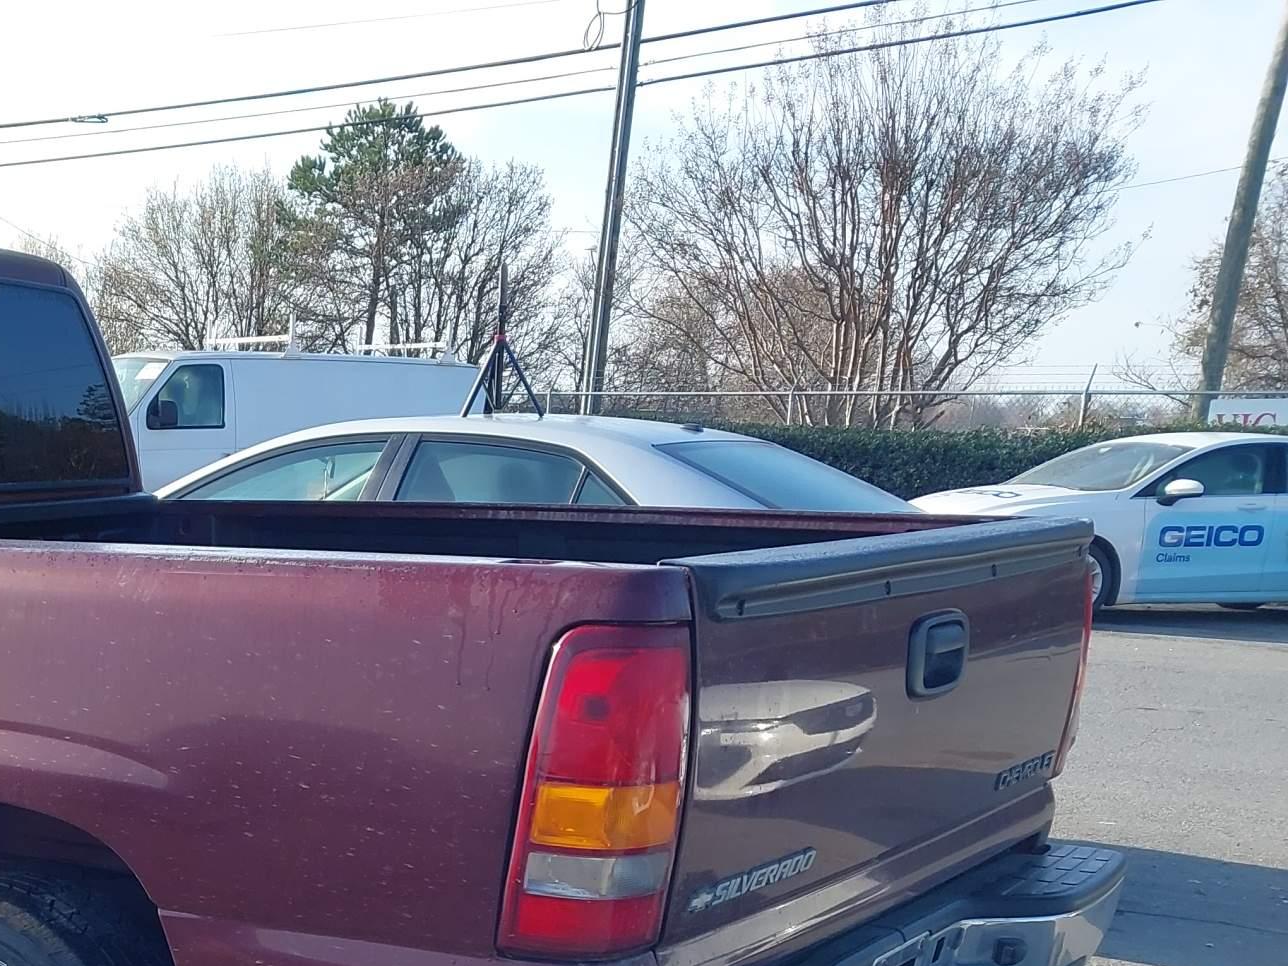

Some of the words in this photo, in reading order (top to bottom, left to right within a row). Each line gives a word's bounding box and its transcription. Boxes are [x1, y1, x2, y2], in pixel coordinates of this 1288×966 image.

[1158, 524, 1265, 548] GEICO
[1155, 552, 1191, 563] Claims
[712, 849, 817, 906] SILVERADO
